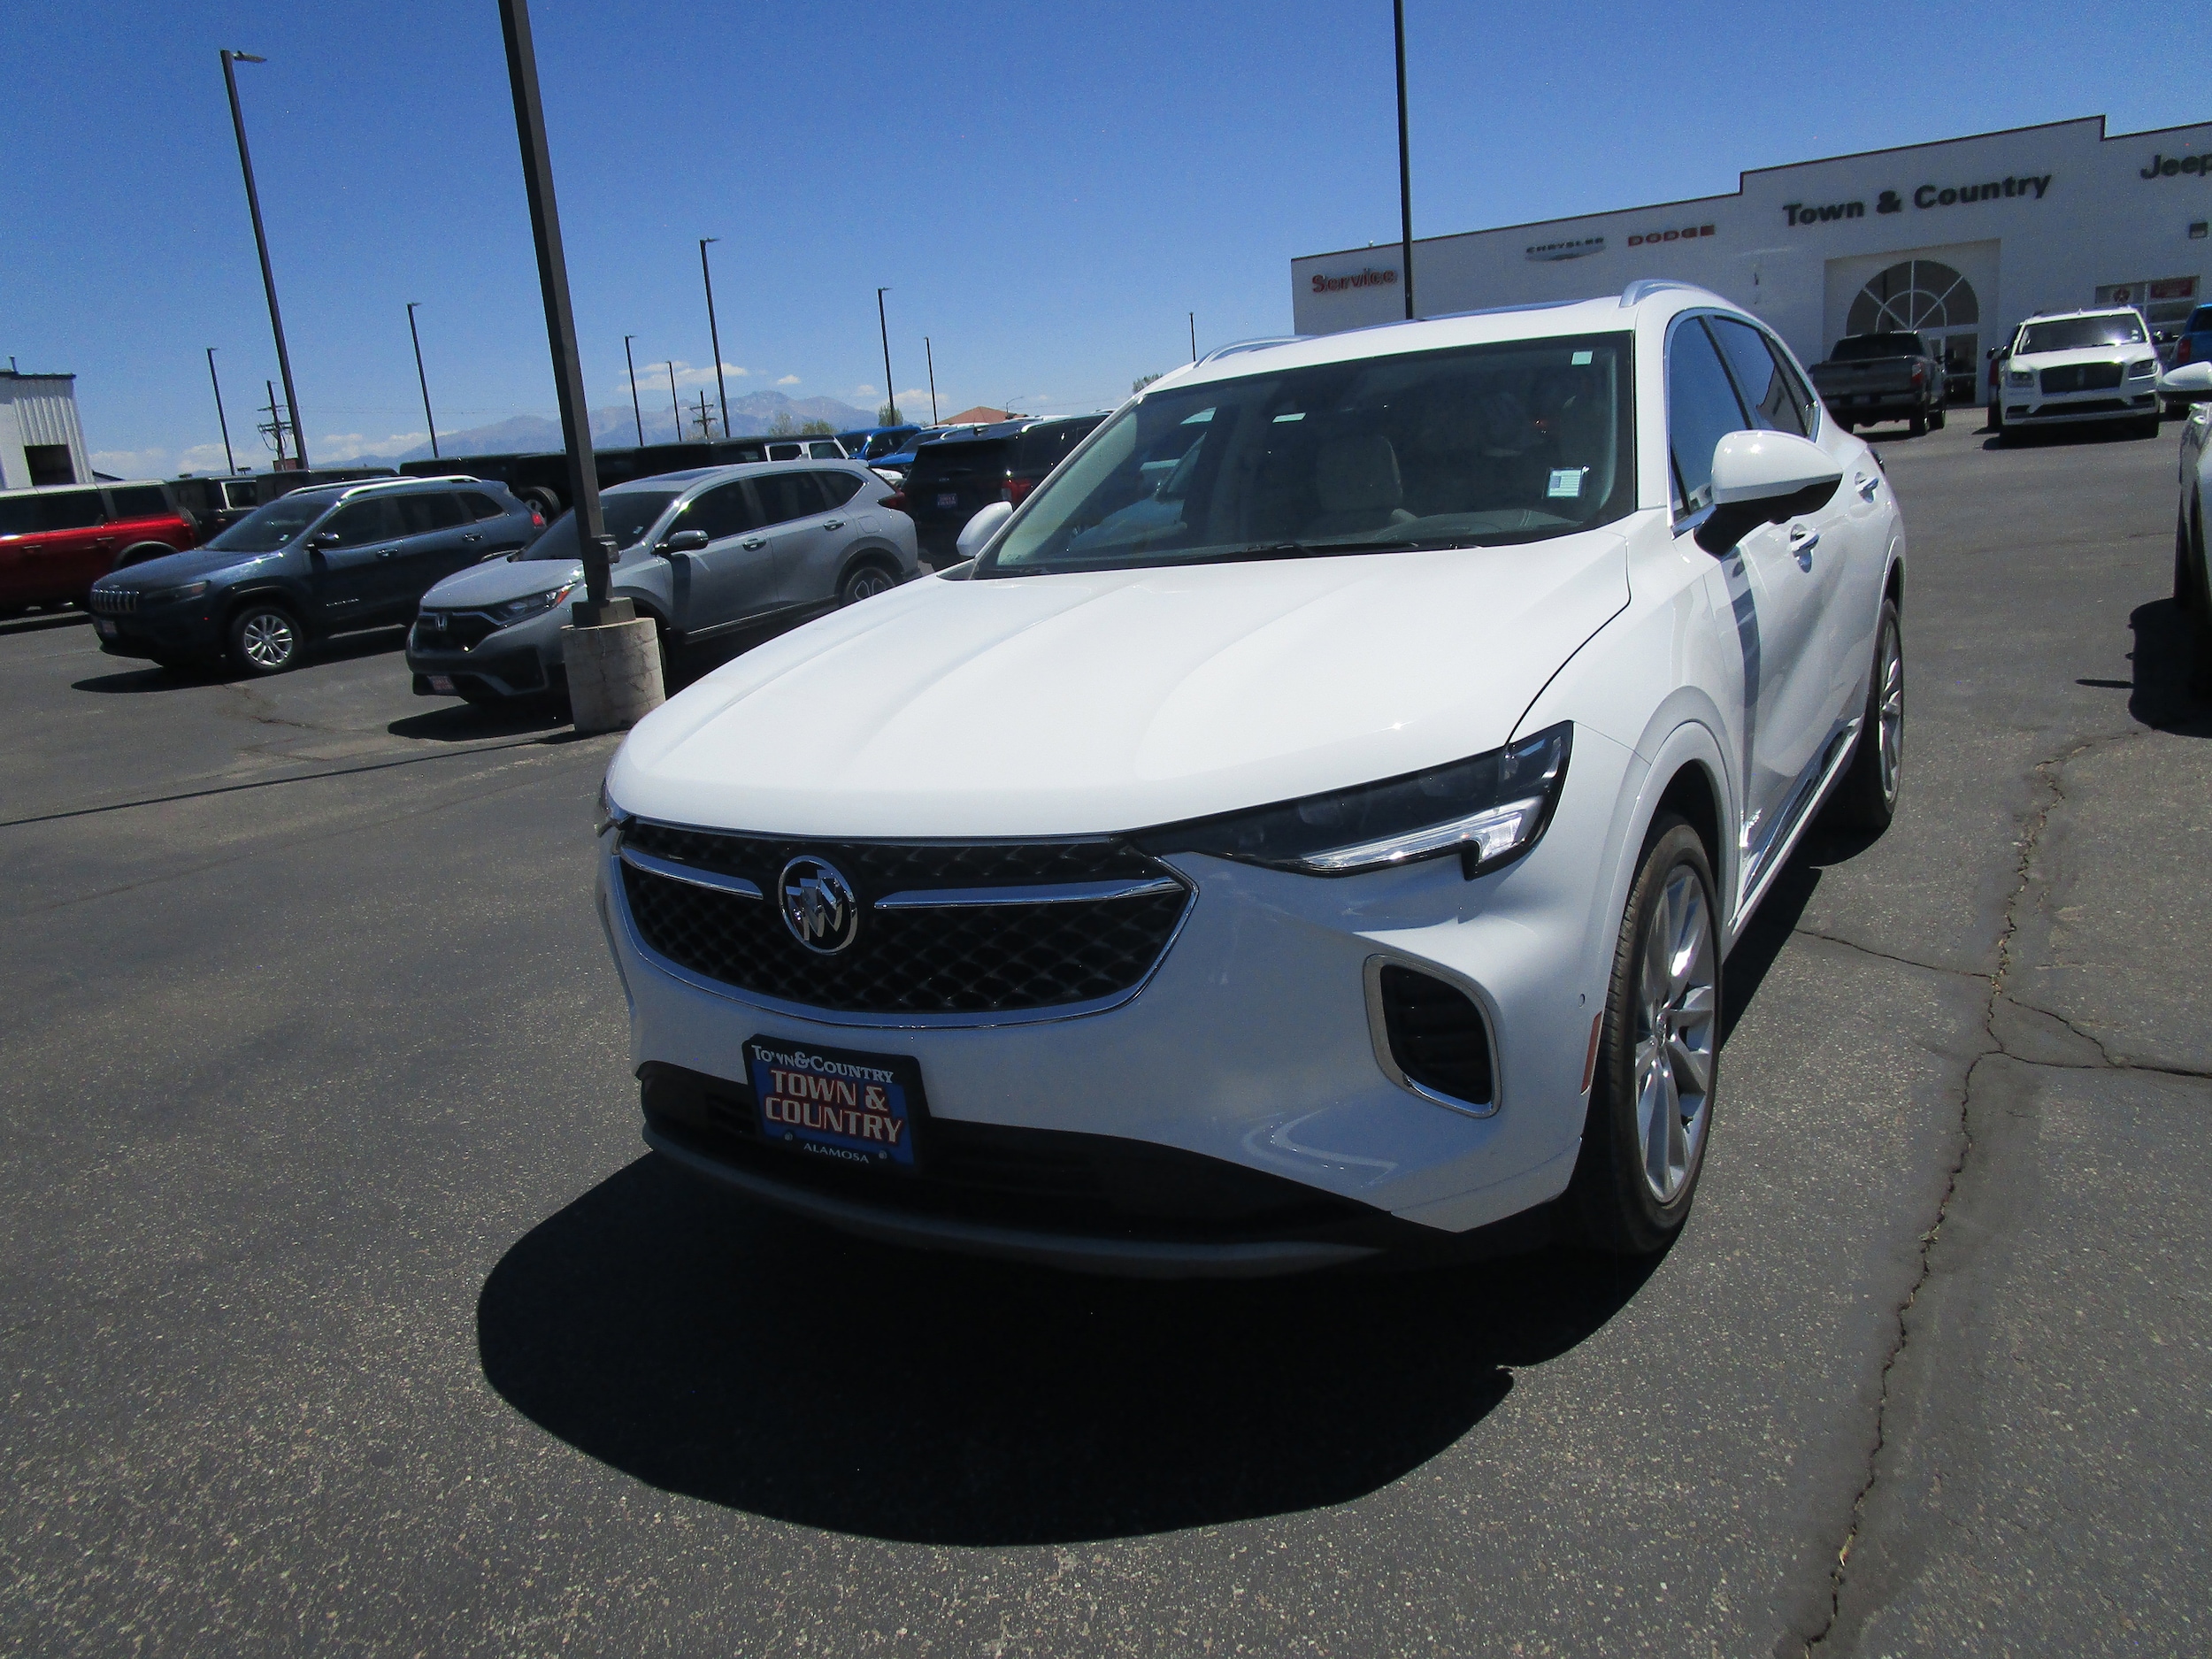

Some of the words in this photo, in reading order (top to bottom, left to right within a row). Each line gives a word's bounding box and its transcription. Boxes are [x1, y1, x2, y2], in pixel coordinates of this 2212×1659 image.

[2140, 153, 2212, 179] Jeep
[1783, 203, 1864, 226] Town
[1877, 190, 1901, 214] &
[1914, 174, 2052, 209] Country
[1628, 225, 1715, 247] DODGE
[1312, 268, 1395, 293] Service
[771, 1070, 856, 1106] TOWN
[865, 1086, 887, 1111] &
[765, 1096, 902, 1142] COUNTRY
[803, 1142, 869, 1164] ALAMOSA
